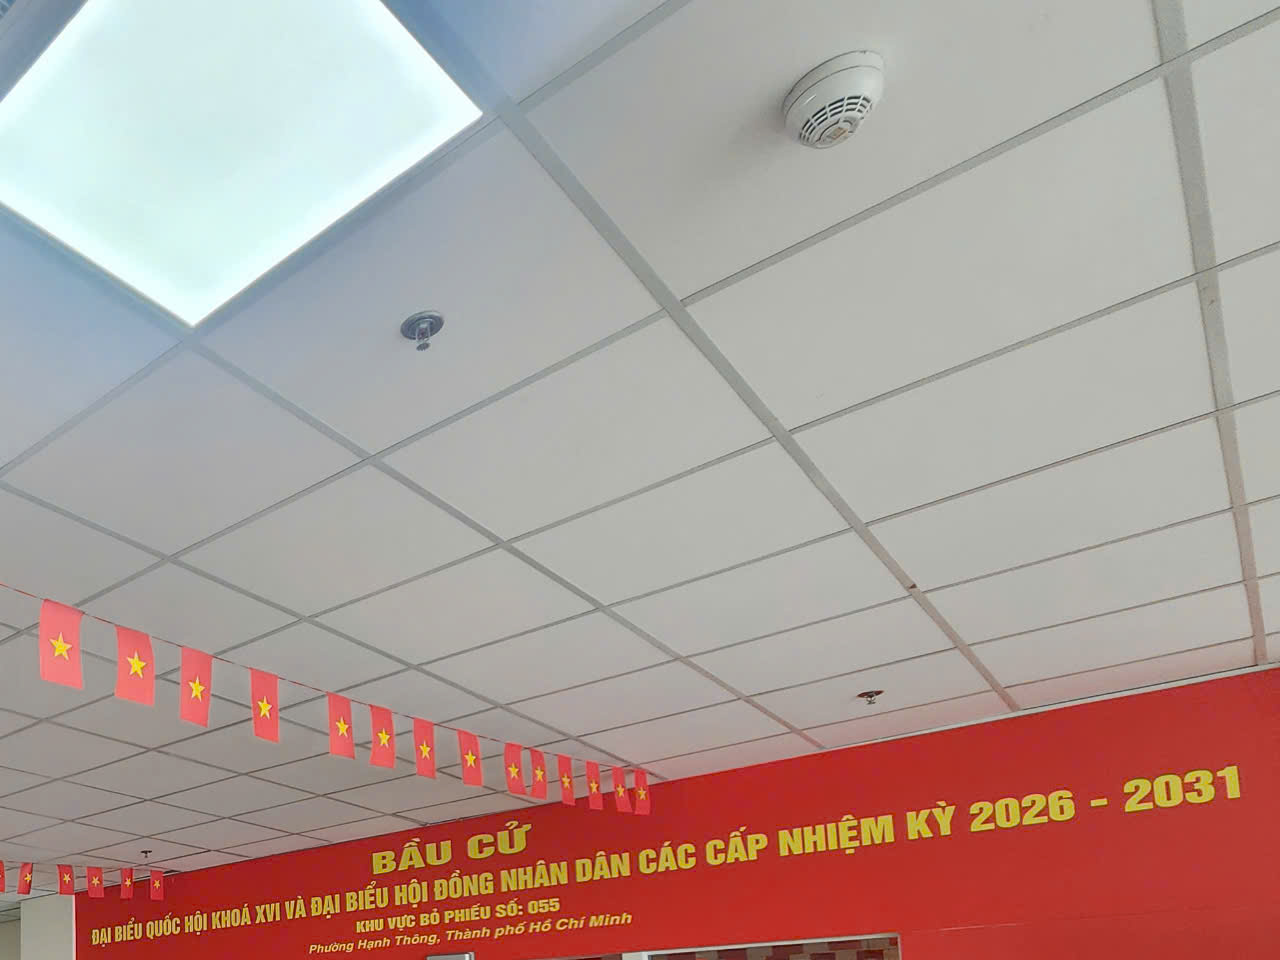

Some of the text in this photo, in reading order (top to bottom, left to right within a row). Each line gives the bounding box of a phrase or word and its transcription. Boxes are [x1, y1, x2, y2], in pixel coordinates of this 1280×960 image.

[92, 765, 1240, 947] ĐẠI BIỂU QUỐC HỘI KHOÁ XVI VÀ ĐẠI BIỂU HỘI ĐỒNG NHÂN DÂN CÁC CẤP NHIỆM KỲ 2026 - 2031
[372, 821, 532, 875] BẦU CỬ
[309, 911, 632, 955] Phường Hạnh Thông, Thành phố Hồ Chí Minh
[356, 898, 560, 934] KHU VỰC BỎ PHIẾU SỐ: 055
